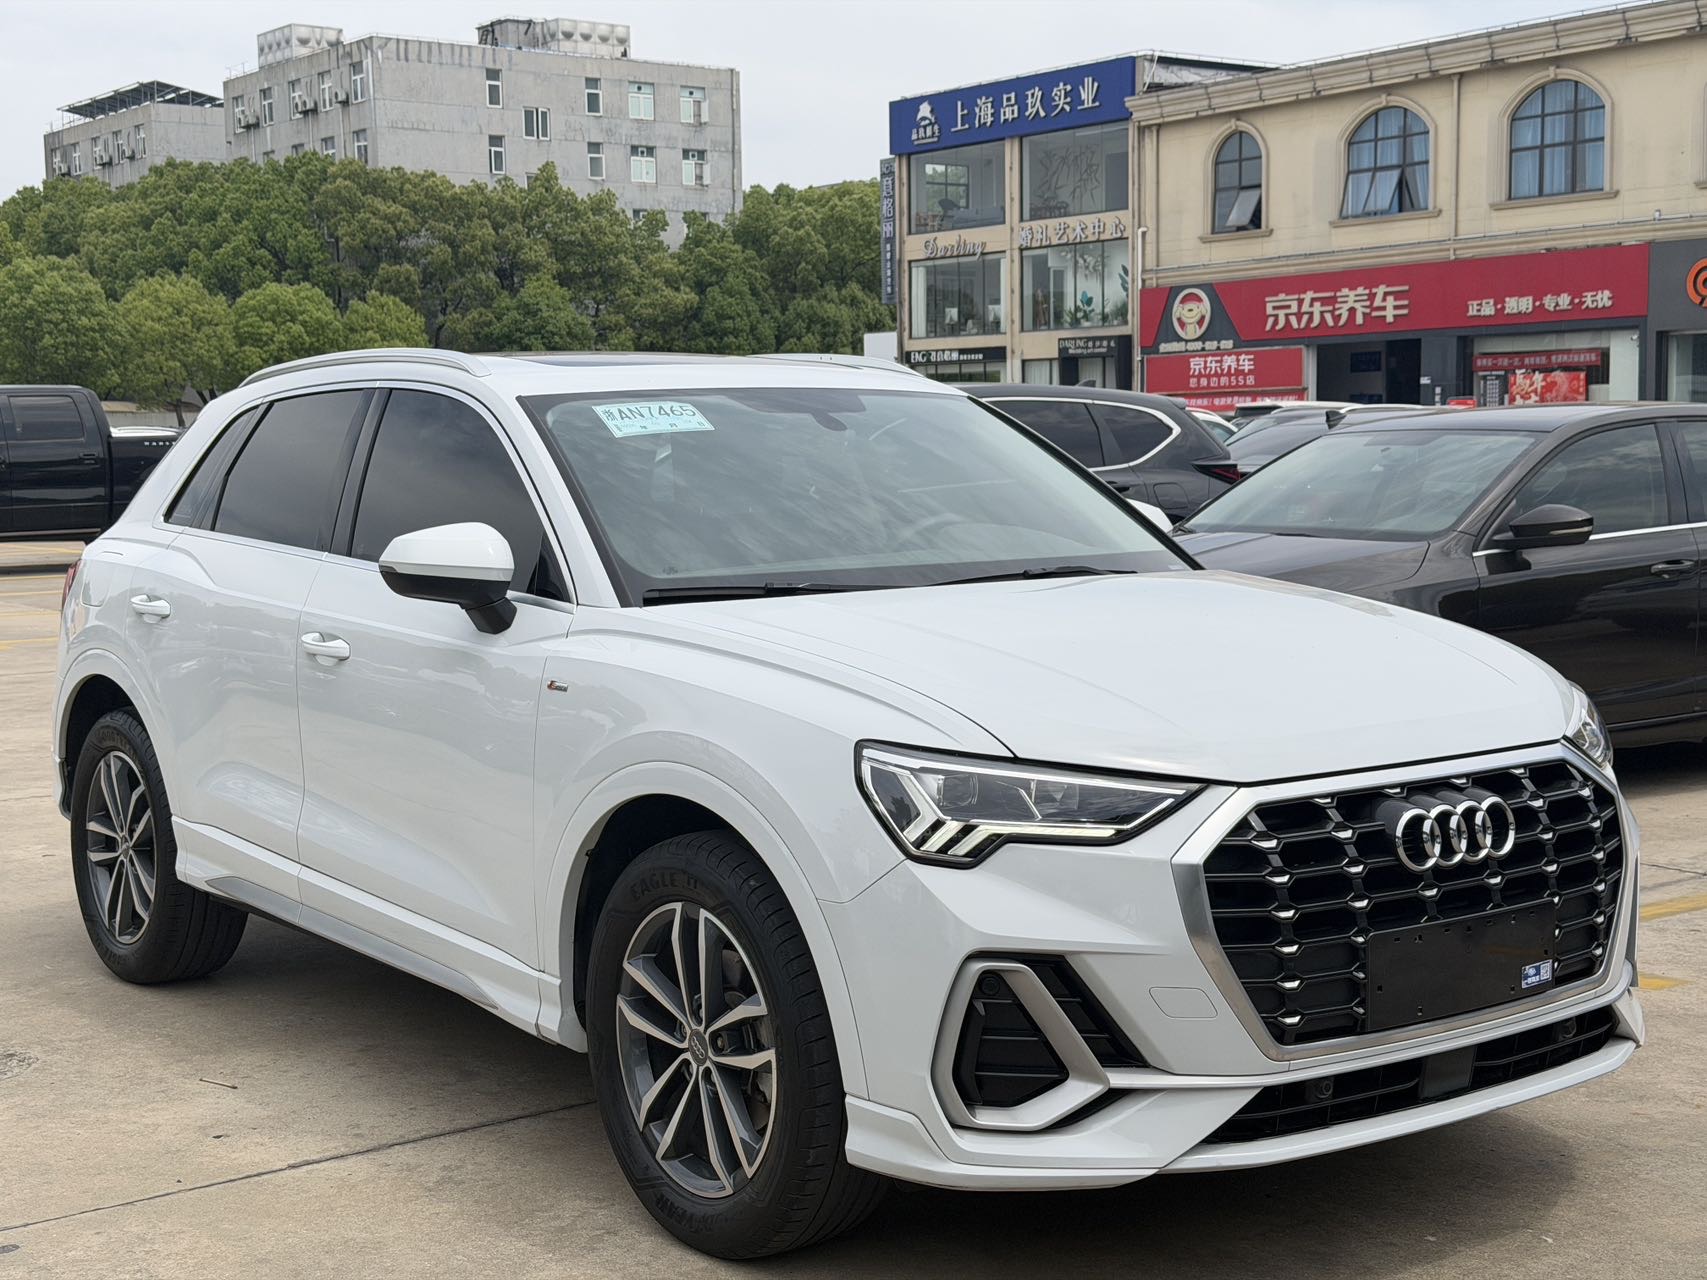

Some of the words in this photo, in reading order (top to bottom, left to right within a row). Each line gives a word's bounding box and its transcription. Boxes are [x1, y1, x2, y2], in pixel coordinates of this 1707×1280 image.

[951, 76, 1100, 132] 上海品玖实业
[1019, 216, 1126, 247] 婚礼艺术中心
[1265, 284, 1410, 331] 京东养车
[1189, 354, 1255, 375] 京东养车
[1189, 376, 1255, 388] 您身边的5S店
